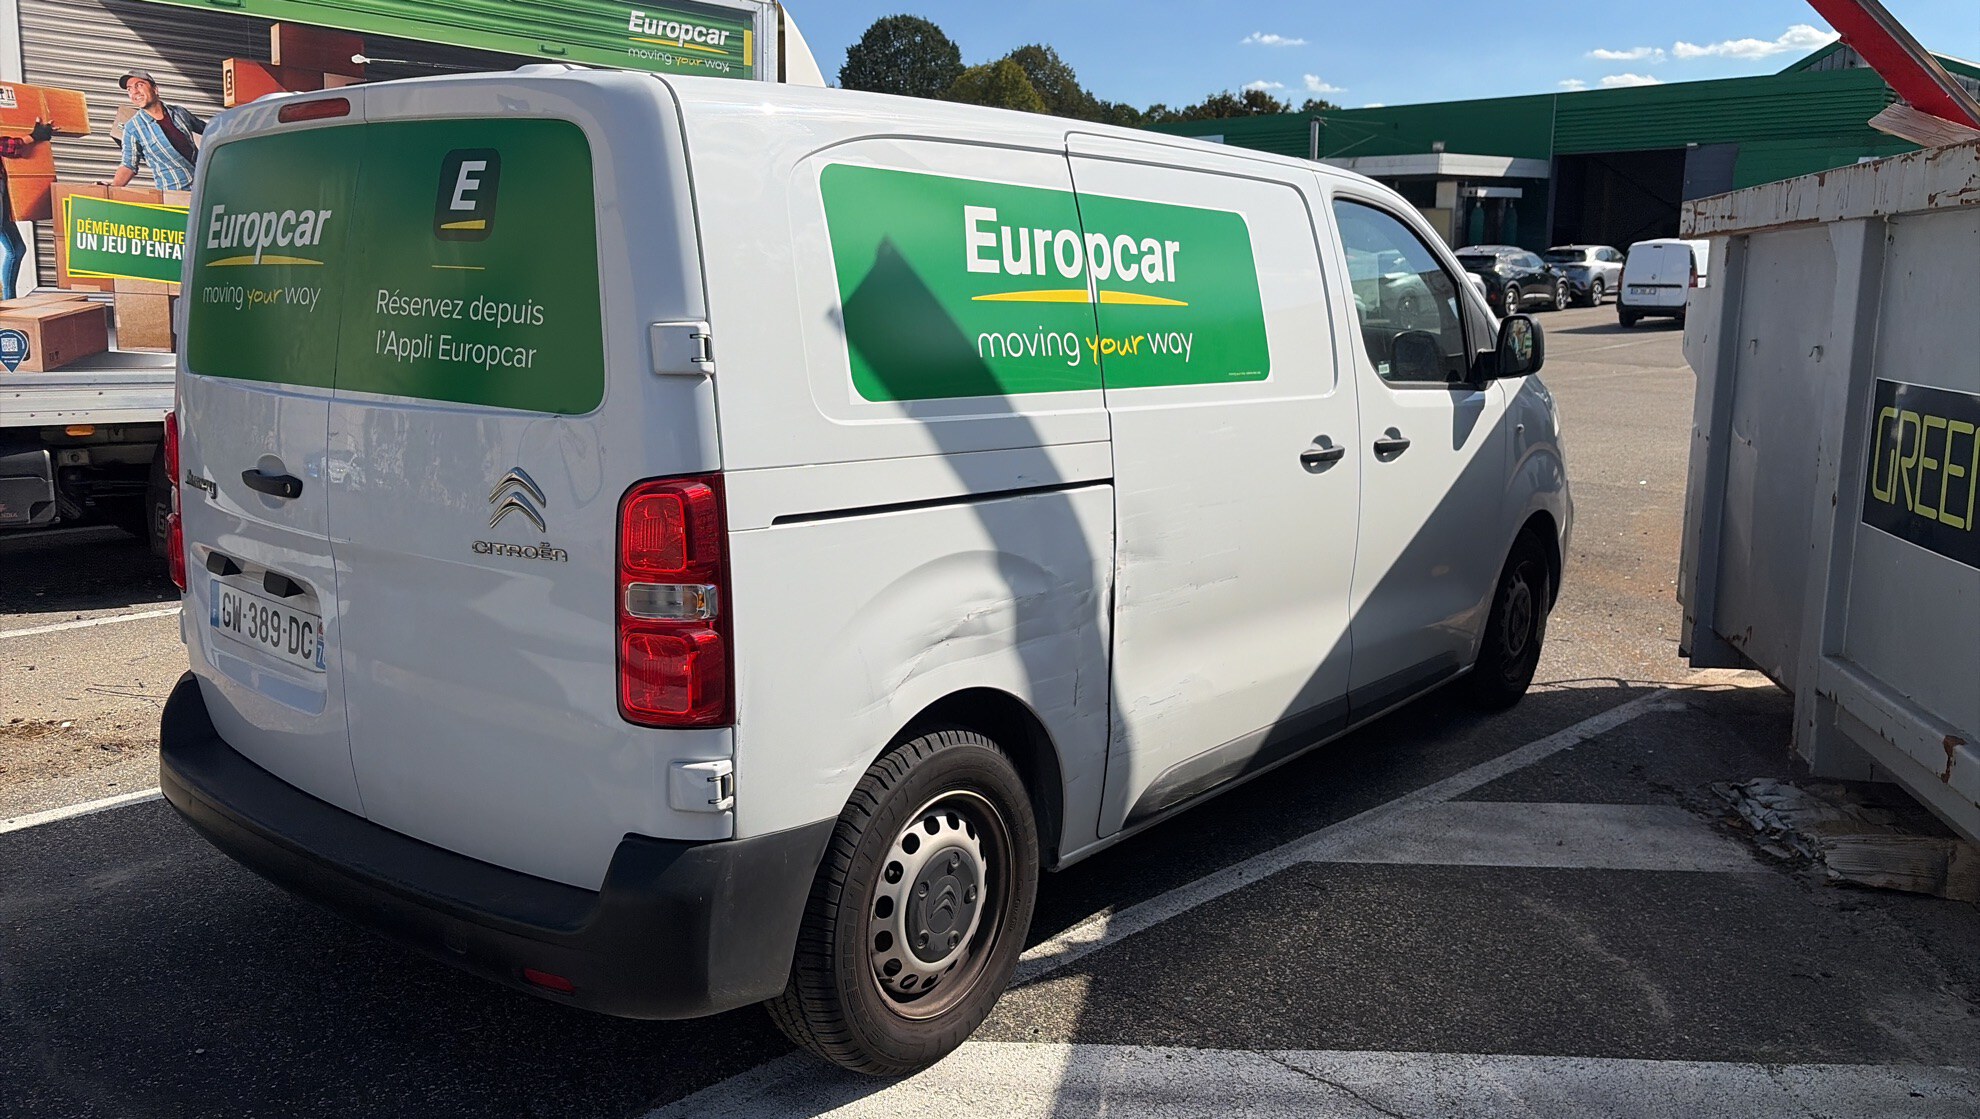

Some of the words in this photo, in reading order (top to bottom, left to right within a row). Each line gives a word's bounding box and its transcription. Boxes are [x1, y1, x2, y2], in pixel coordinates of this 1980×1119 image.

[628, 10, 730, 47] Europcar
[628, 47, 672, 65] moving
[675, 56, 702, 66] your
[704, 58, 730, 73] way
[450, 160, 487, 210] E
[76, 232, 98, 251] UN
[101, 236, 127, 254] JEU
[131, 238, 186, 260] D'ENFA
[77, 217, 149, 240] DÉMÉNAGER
[207, 204, 332, 264] Europcar
[964, 205, 1180, 303] Europcar
[203, 282, 244, 310] moving
[247, 288, 283, 310] your
[285, 287, 321, 312] way
[376, 289, 464, 319] Réservez
[469, 295, 544, 329] depuis
[376, 330, 433, 363] l'Appli
[438, 335, 537, 371] Europcar
[977, 325, 1081, 367] moving
[1085, 334, 1145, 365] your
[1147, 332, 1193, 363] way
[222, 592, 313, 660] GW-389-DC
